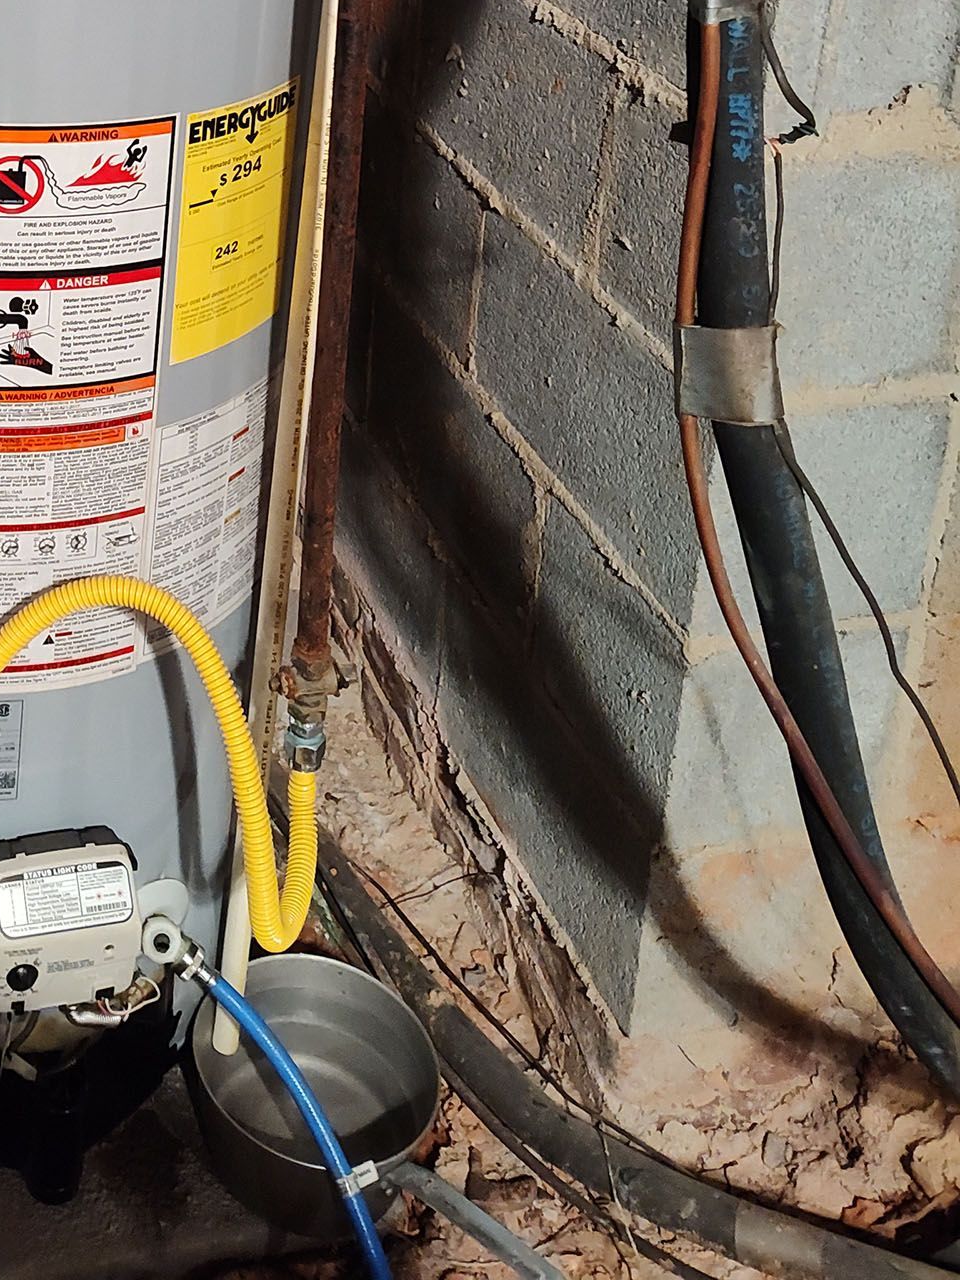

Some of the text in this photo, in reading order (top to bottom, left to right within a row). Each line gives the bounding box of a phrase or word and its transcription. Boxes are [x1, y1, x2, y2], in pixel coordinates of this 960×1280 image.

[59, 129, 119, 143] WARNING
[202, 158, 231, 173] Estimated
[232, 151, 248, 164] Yearly
[231, 155, 262, 183] 294
[67, 192, 127, 203] Flammable Vapors
[214, 240, 239, 260] 242
[56, 275, 109, 289] DANGER
[303, 315, 312, 338] WATER
[299, 341, 309, 376] DRINKING
[5, 392, 48, 401] WARNING
[54, 385, 115, 399] ADVERTENCIA
[23, 863, 98, 880] STATUS LIGHT CODE
